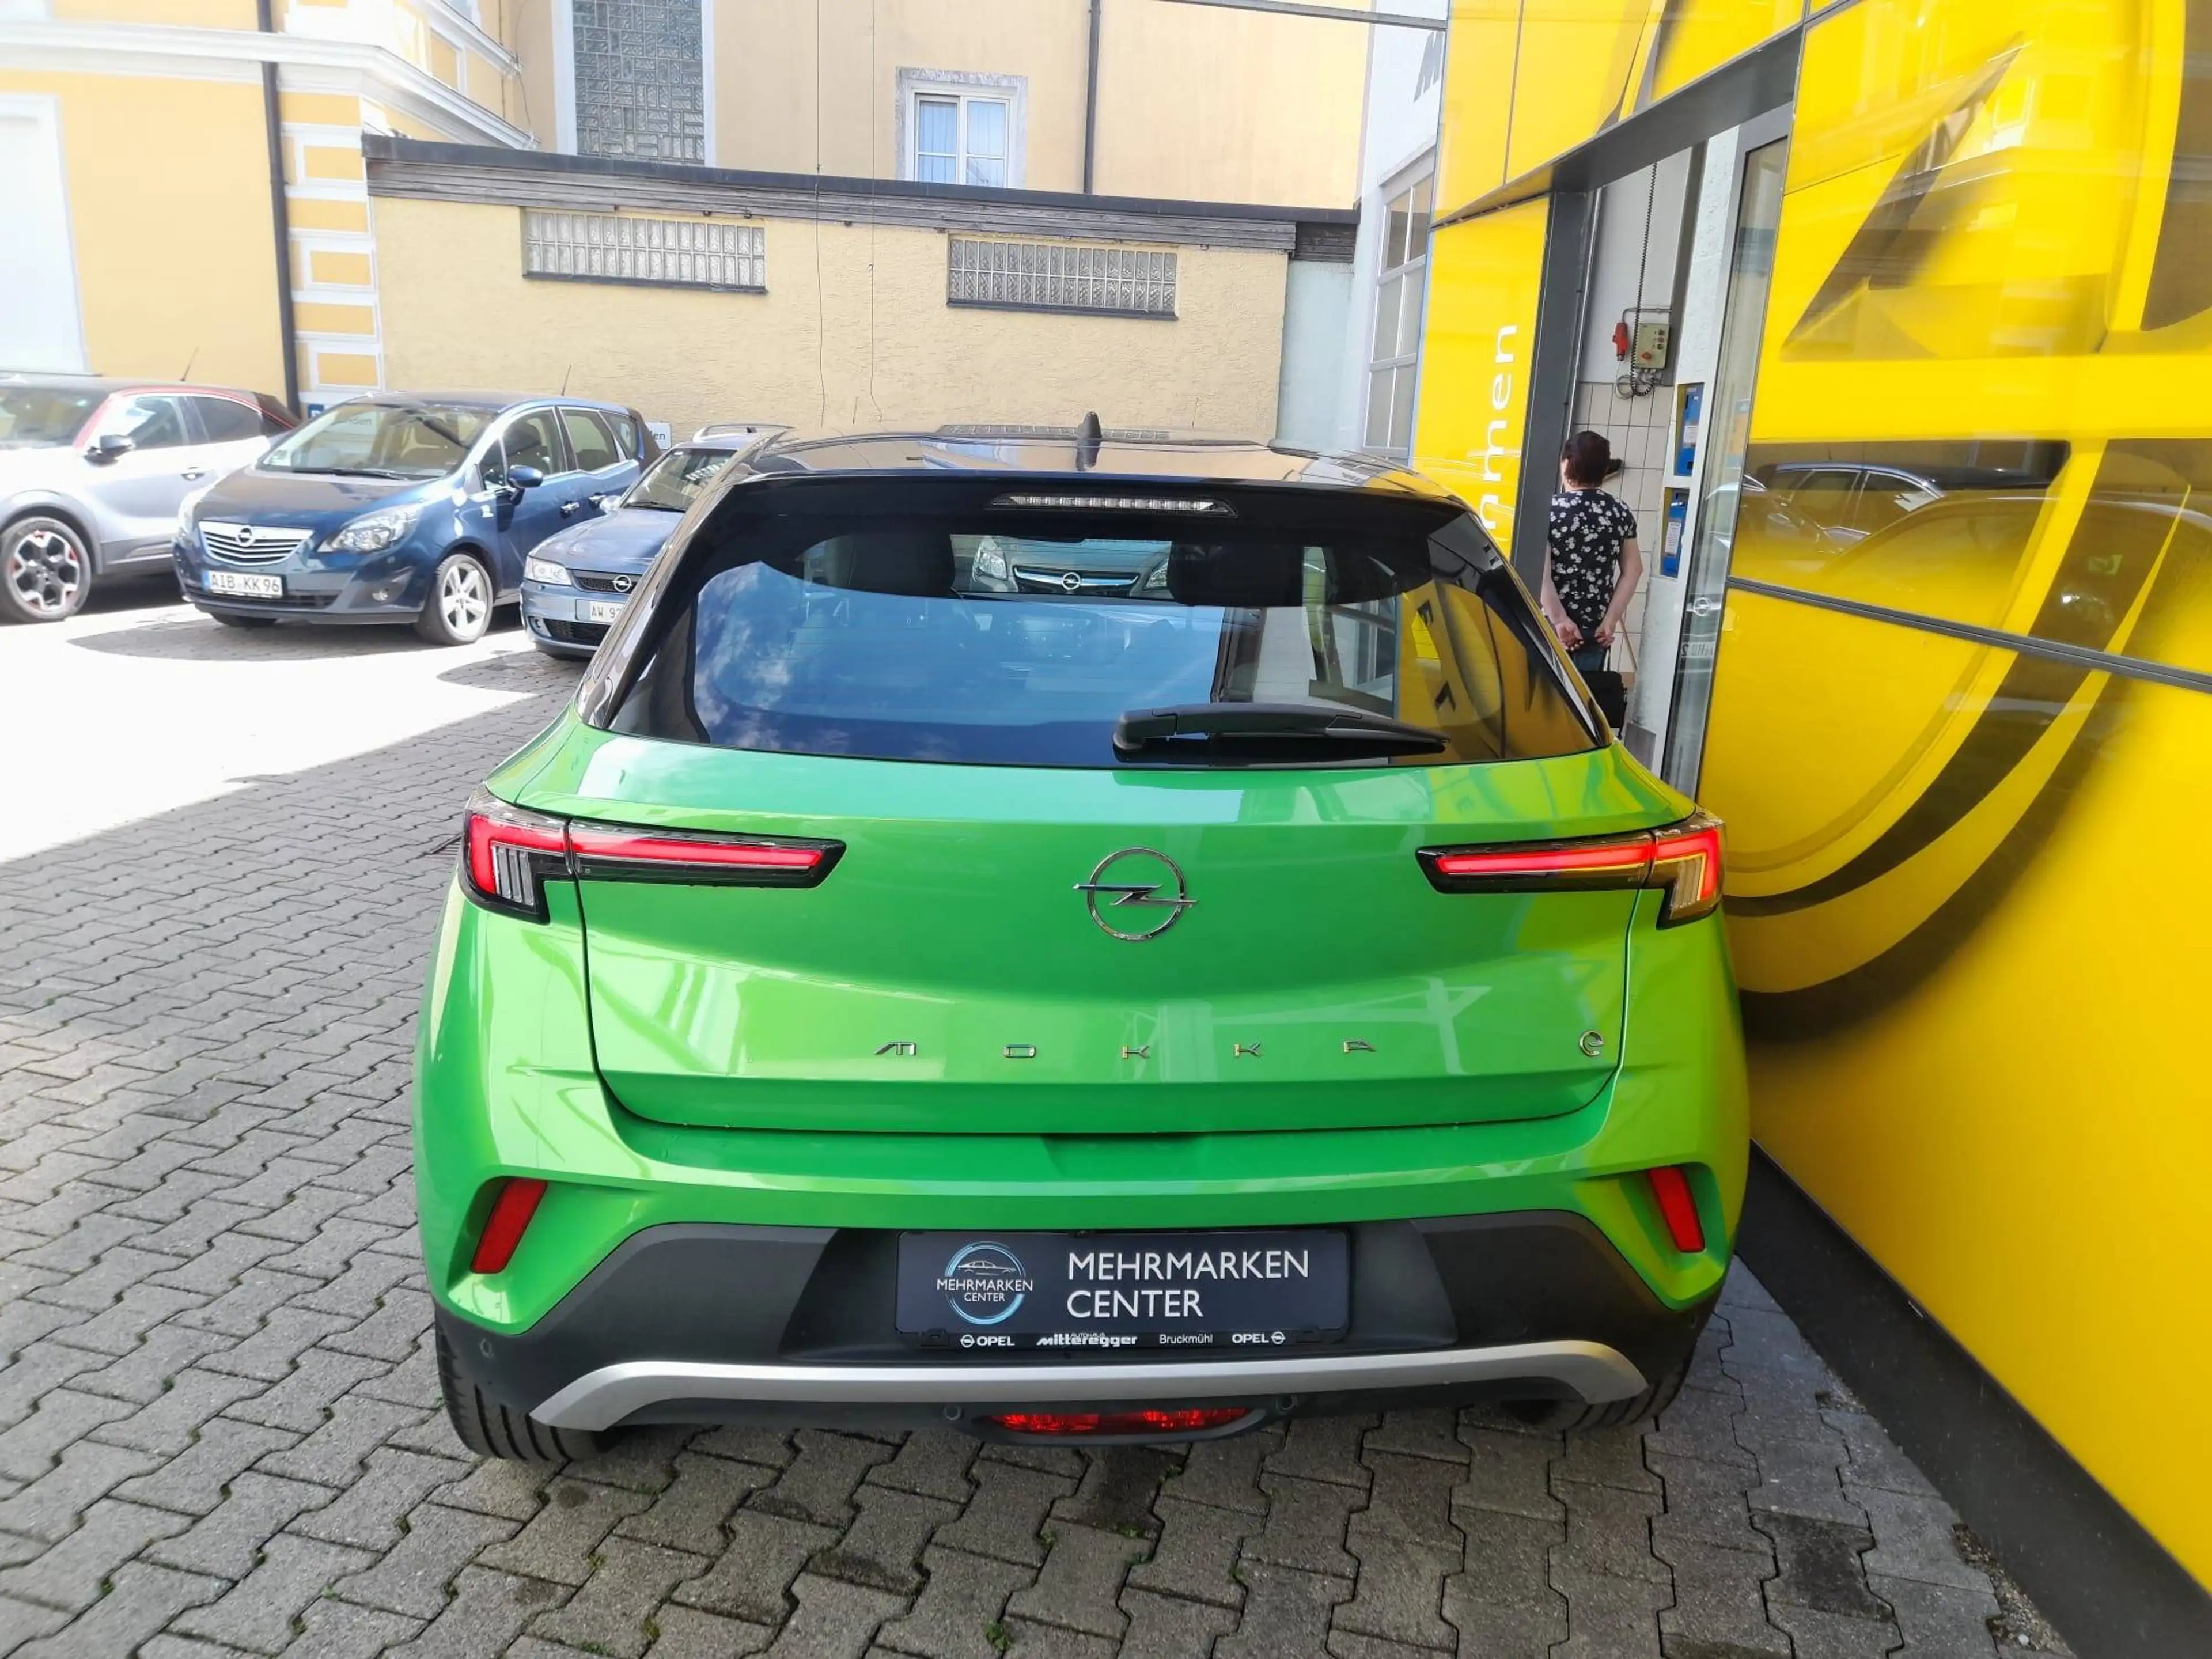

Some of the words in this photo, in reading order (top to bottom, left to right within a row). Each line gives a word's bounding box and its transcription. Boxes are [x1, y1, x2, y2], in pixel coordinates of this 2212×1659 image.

[1068, 1250, 1309, 1281] MEHRMARKEN
[936, 1278, 1033, 1291] MEHRMARKEN
[964, 1292, 1005, 1302] CENTER
[1067, 1290, 1204, 1318] CENTER
[976, 1336, 1014, 1346] OPEL
[1159, 1334, 1213, 1344] Bruckmühl
[1232, 1333, 1269, 1344] OPEL
